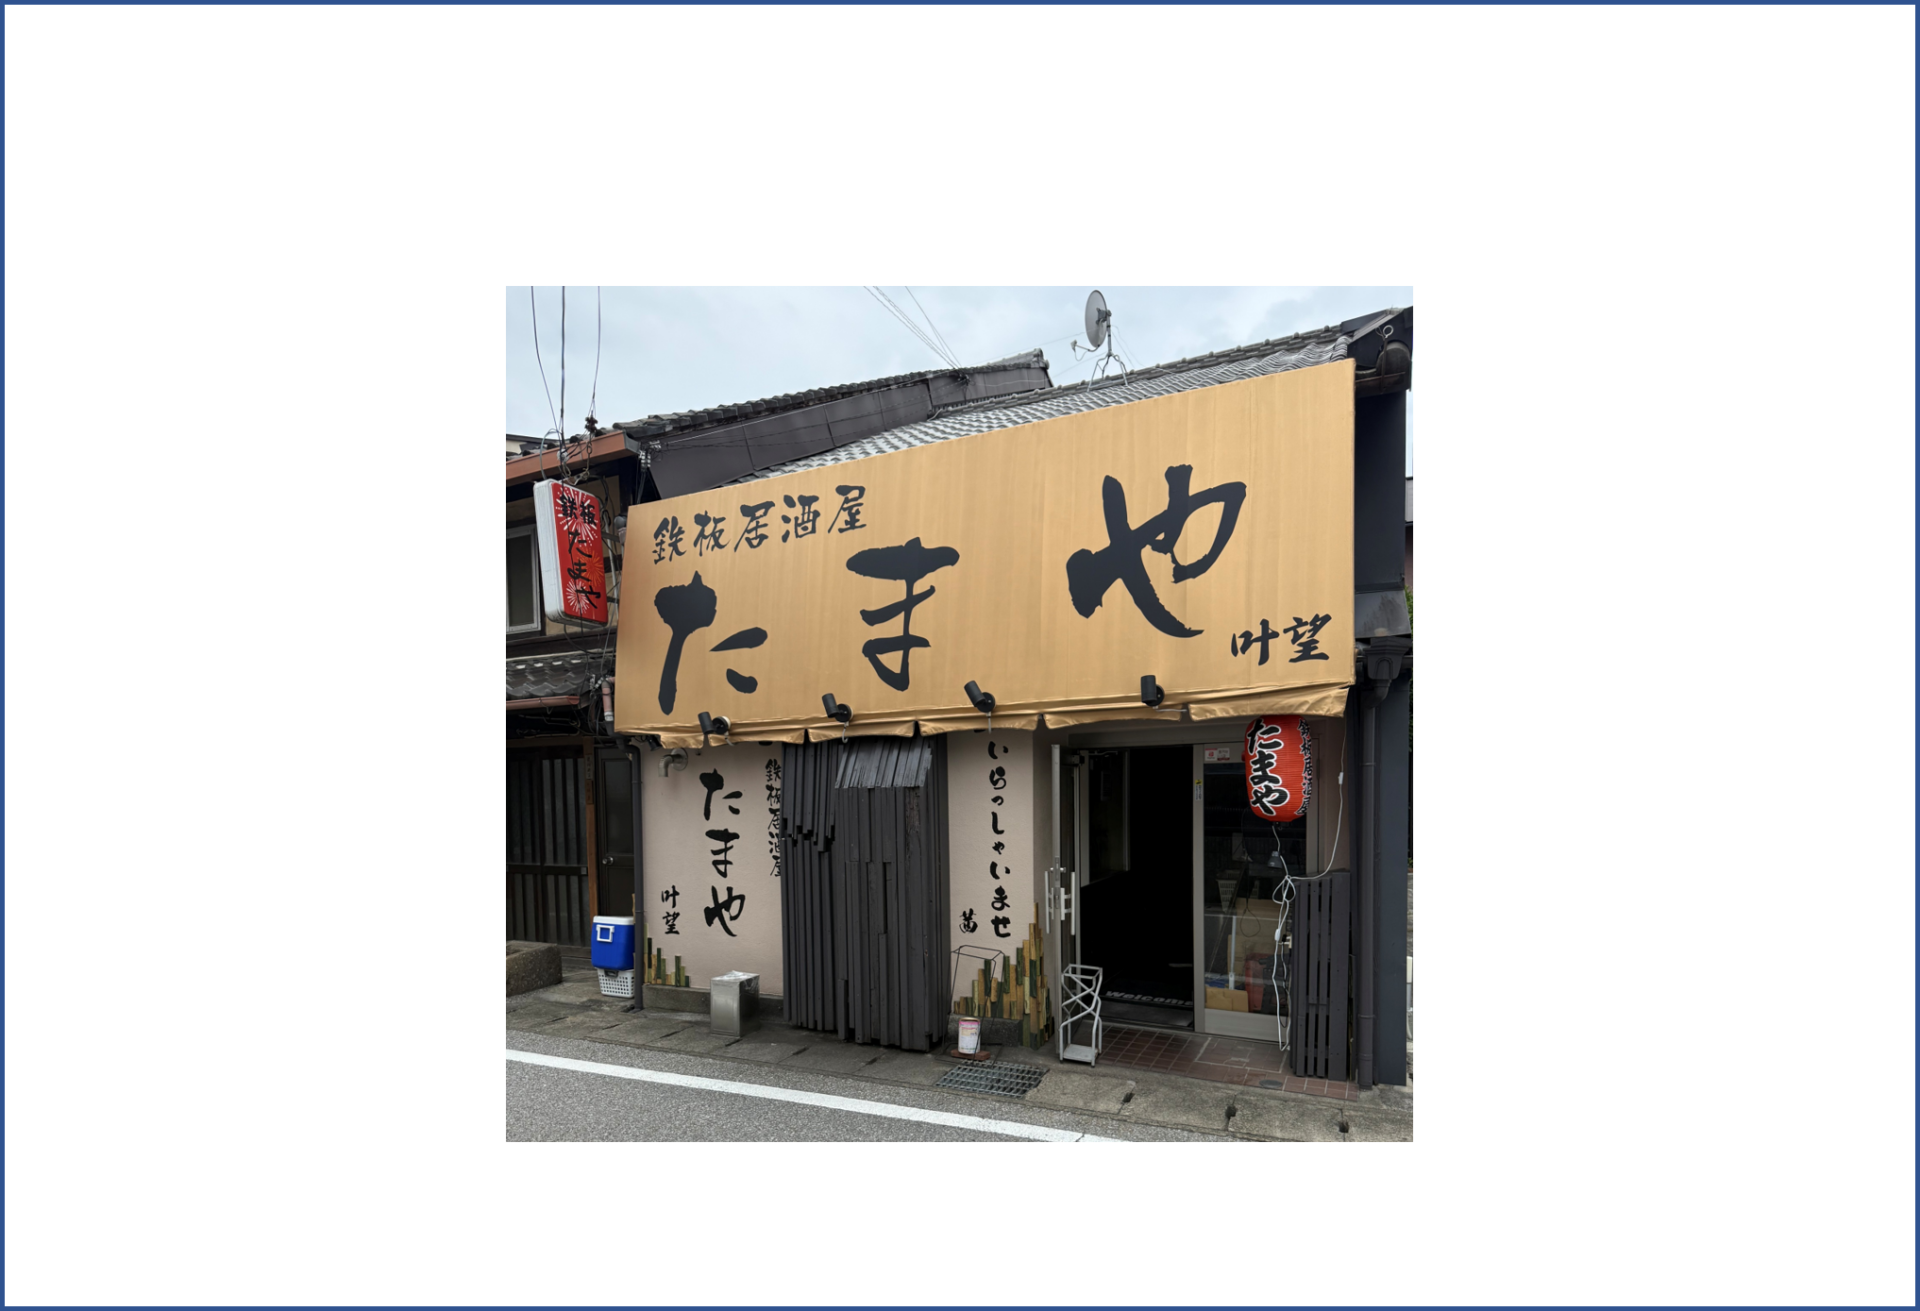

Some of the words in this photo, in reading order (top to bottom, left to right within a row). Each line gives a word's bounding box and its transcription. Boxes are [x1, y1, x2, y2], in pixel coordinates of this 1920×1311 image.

[560, 496, 597, 526] 鉄板
[652, 485, 867, 565] 鉄板居酒屋
[566, 528, 601, 610] たまや
[654, 464, 1247, 715] たまや
[1230, 613, 1332, 667] 叶望
[1246, 718, 1290, 816] たまや
[698, 768, 746, 938] たまや
[987, 740, 1012, 939] いらっしゃいませ
[661, 884, 681, 935] 叶望
[1105, 990, 1195, 1007] Welcome
